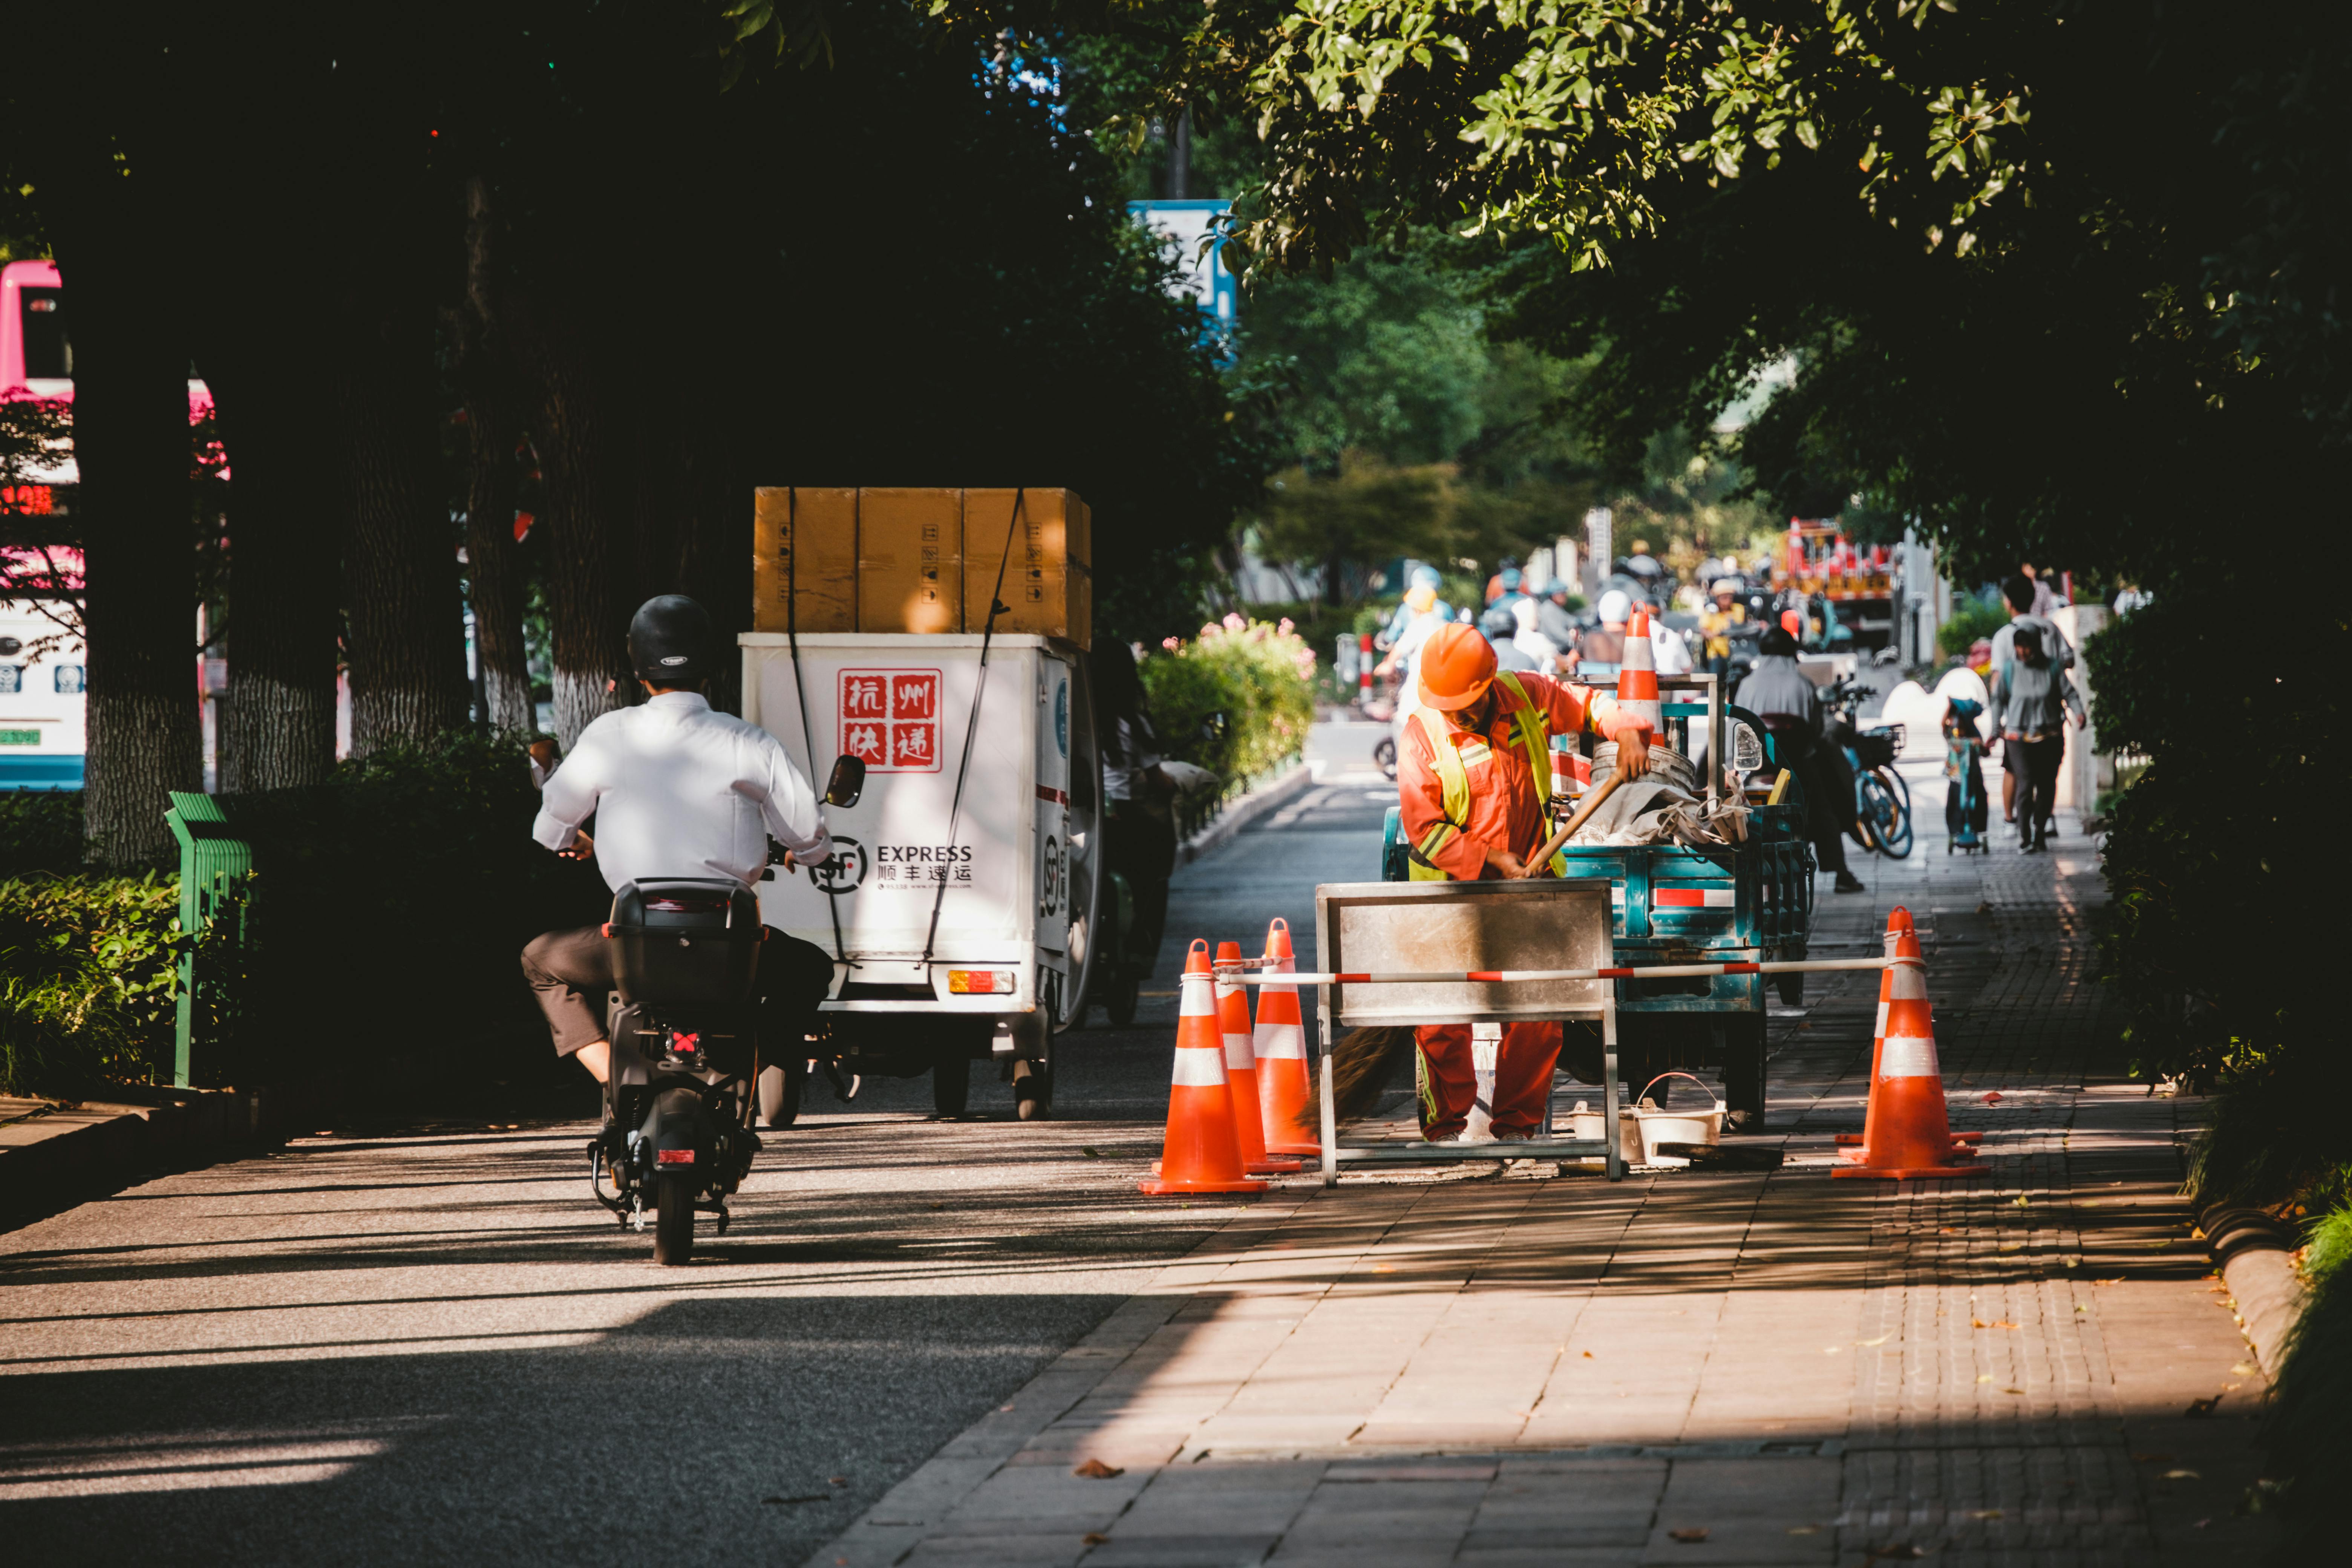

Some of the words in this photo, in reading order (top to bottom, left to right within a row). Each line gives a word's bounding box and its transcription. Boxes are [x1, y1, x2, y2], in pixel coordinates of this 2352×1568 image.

[849, 679, 930, 715] 杭州
[849, 725, 931, 760] 快递
[878, 846, 972, 862] EXPRESS
[877, 865, 972, 881] 顺丰速运
